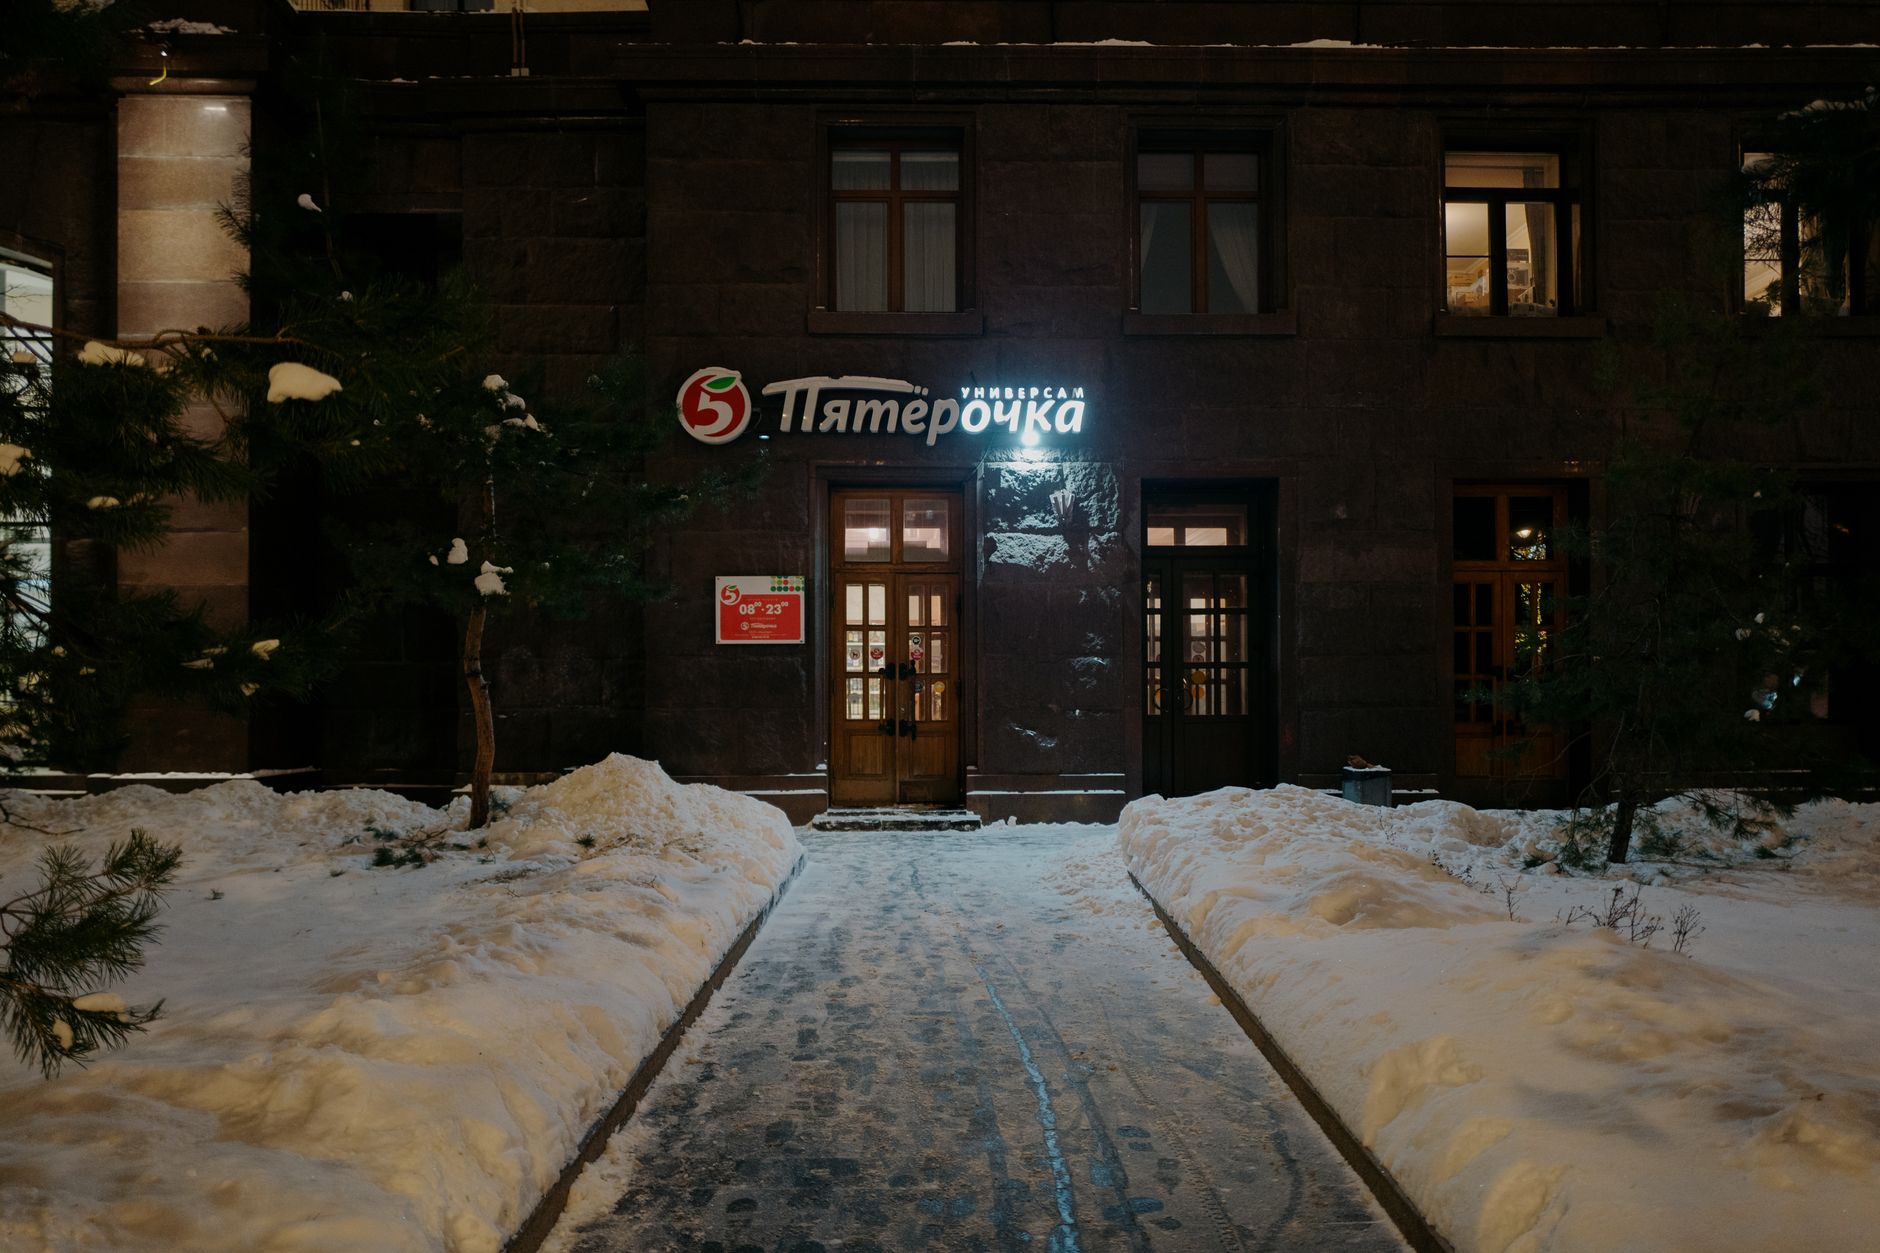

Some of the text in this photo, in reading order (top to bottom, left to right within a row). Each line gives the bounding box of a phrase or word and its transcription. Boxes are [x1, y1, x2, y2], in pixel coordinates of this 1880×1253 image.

[695, 375, 1086, 446] 5 Пятёрочка
[961, 386, 1085, 399] УНИВЕРСАМ
